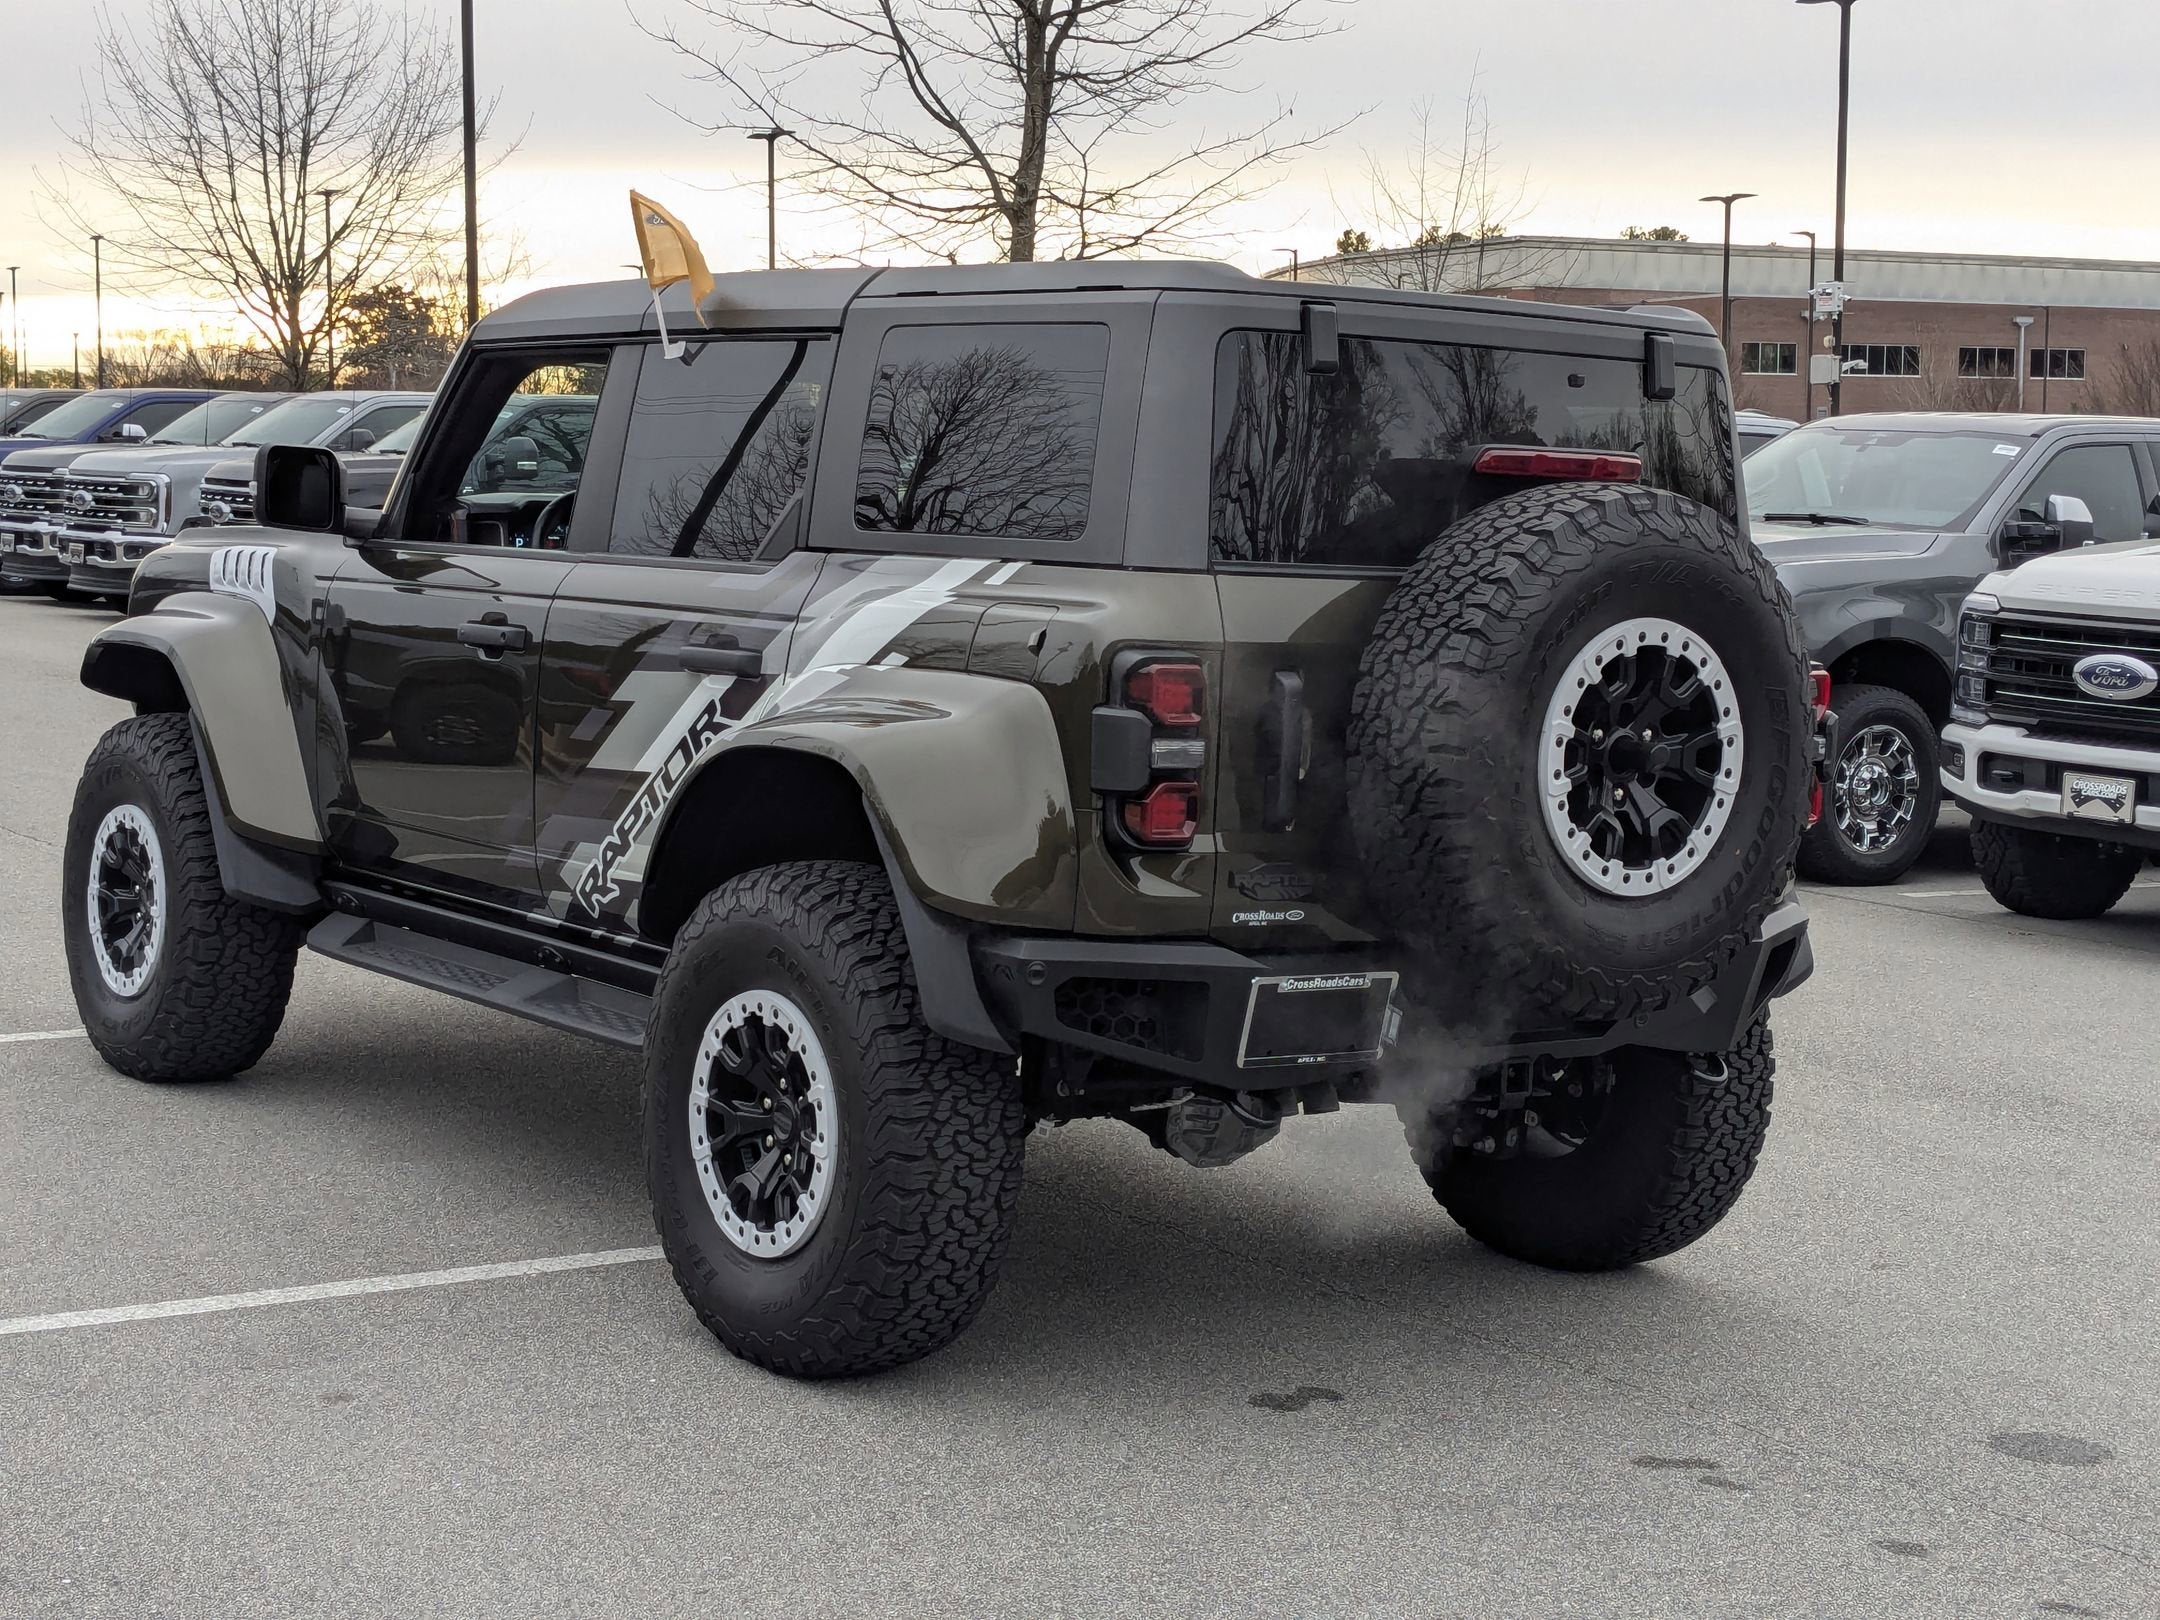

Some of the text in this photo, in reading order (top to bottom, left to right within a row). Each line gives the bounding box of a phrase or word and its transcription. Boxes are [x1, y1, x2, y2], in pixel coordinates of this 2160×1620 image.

[515, 537, 524, 548] P
[2091, 665, 2129, 686] Ford
[2072, 780, 2128, 795] CROSSROADS
[576, 698, 734, 918] RAPTOR
[1287, 976, 1364, 990] CrossRoadsCars
